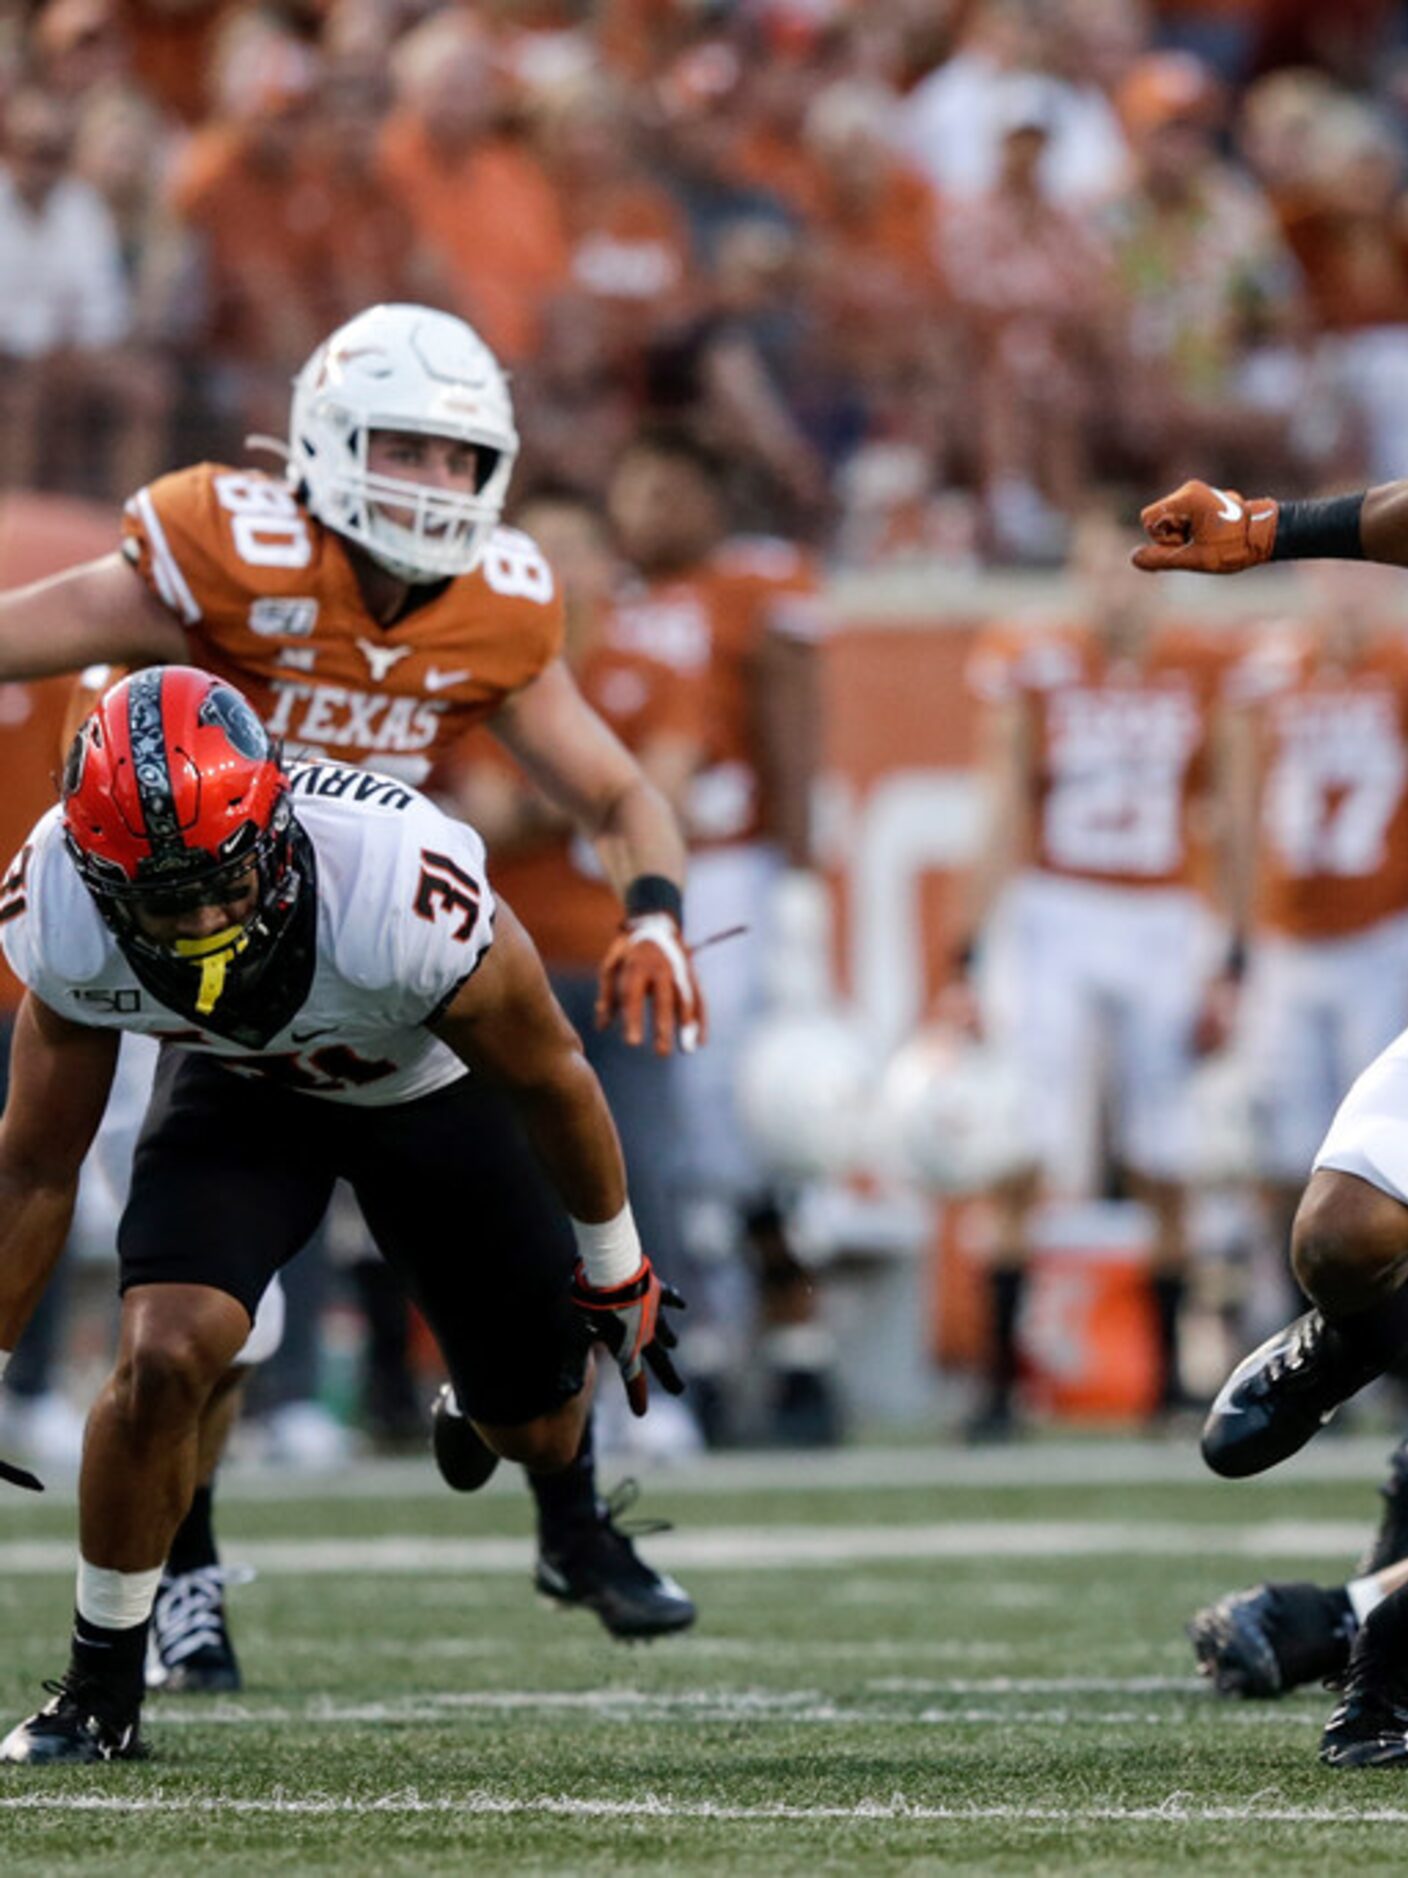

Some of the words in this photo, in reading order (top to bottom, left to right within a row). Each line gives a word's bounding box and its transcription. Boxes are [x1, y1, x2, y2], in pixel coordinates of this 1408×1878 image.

[212, 473, 312, 569] 80
[266, 681, 449, 751] TEXAS
[413, 846, 480, 943] 31
